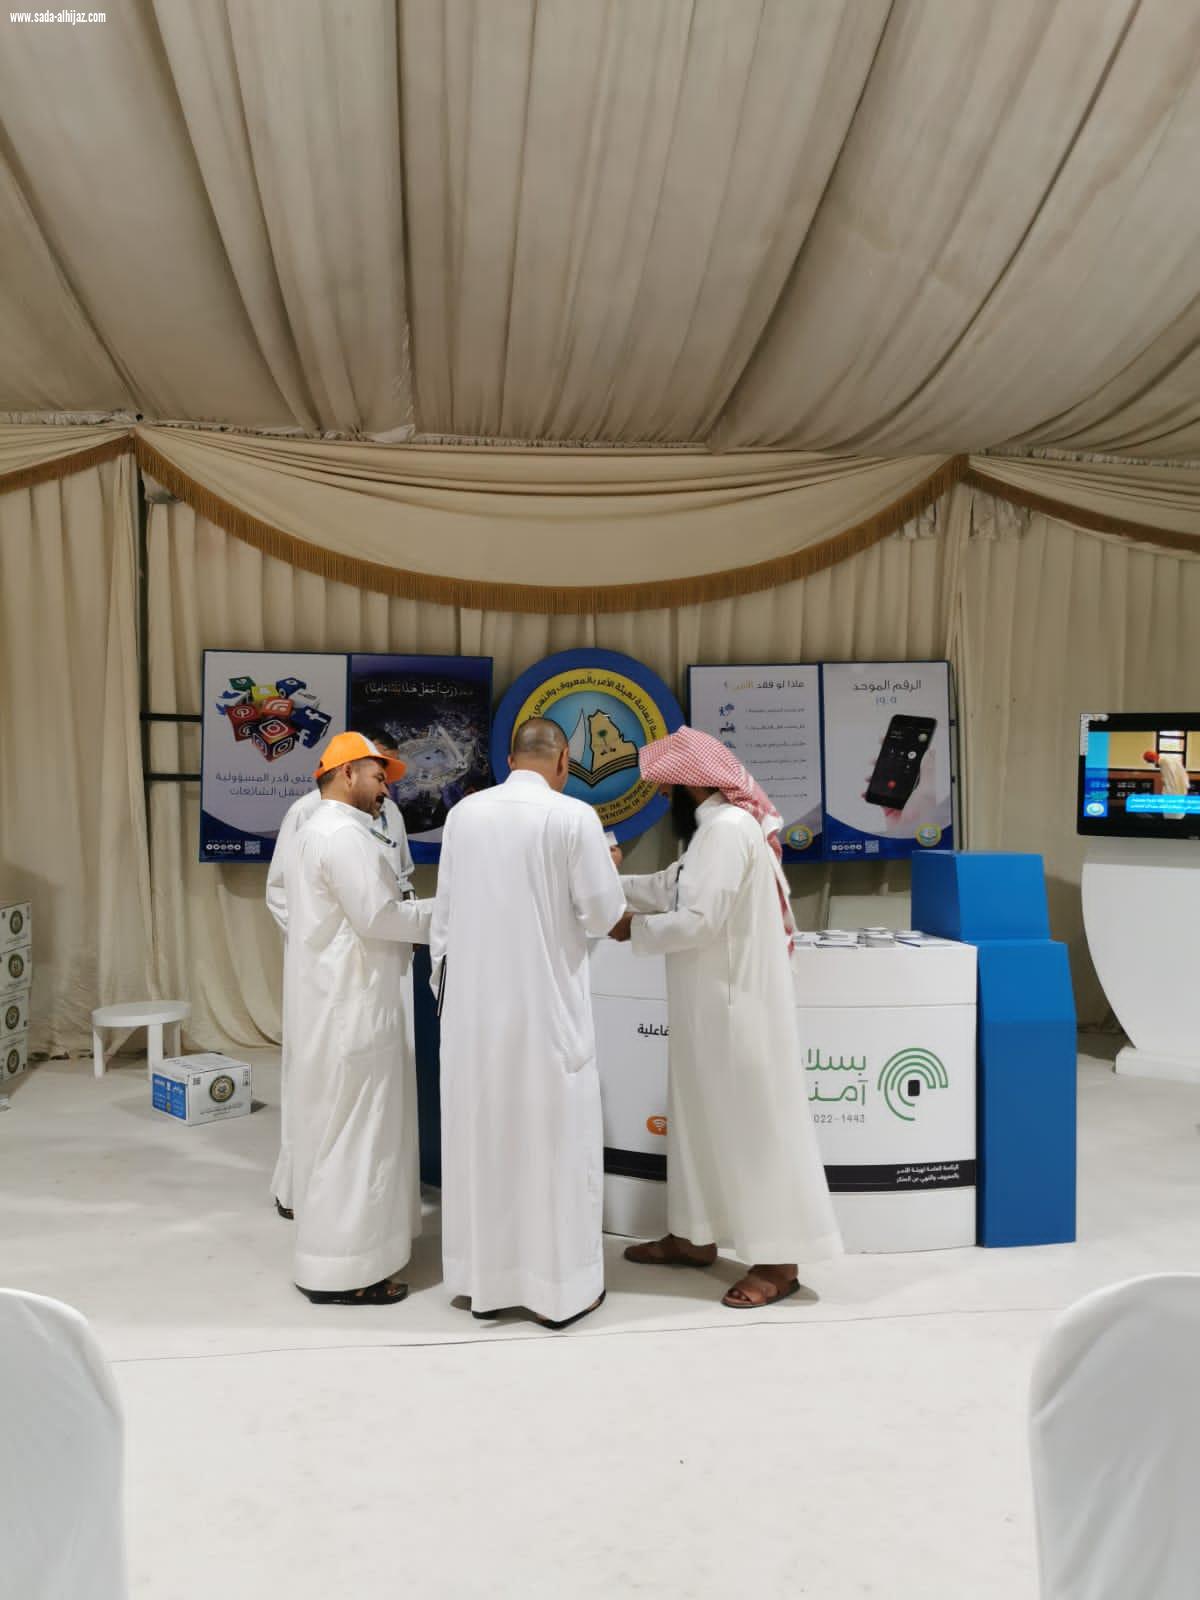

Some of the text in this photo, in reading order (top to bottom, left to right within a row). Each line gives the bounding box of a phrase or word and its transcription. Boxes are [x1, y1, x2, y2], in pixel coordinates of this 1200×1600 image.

[853, 679, 922, 694] الرقم الموحد
[215, 772, 269, 784] المسؤولية
[270, 772, 289, 785] قدر
[804, 1047, 867, 1077] بسلا
[807, 1079, 869, 1107] آمن
[813, 1112, 865, 1125] 022-1443
